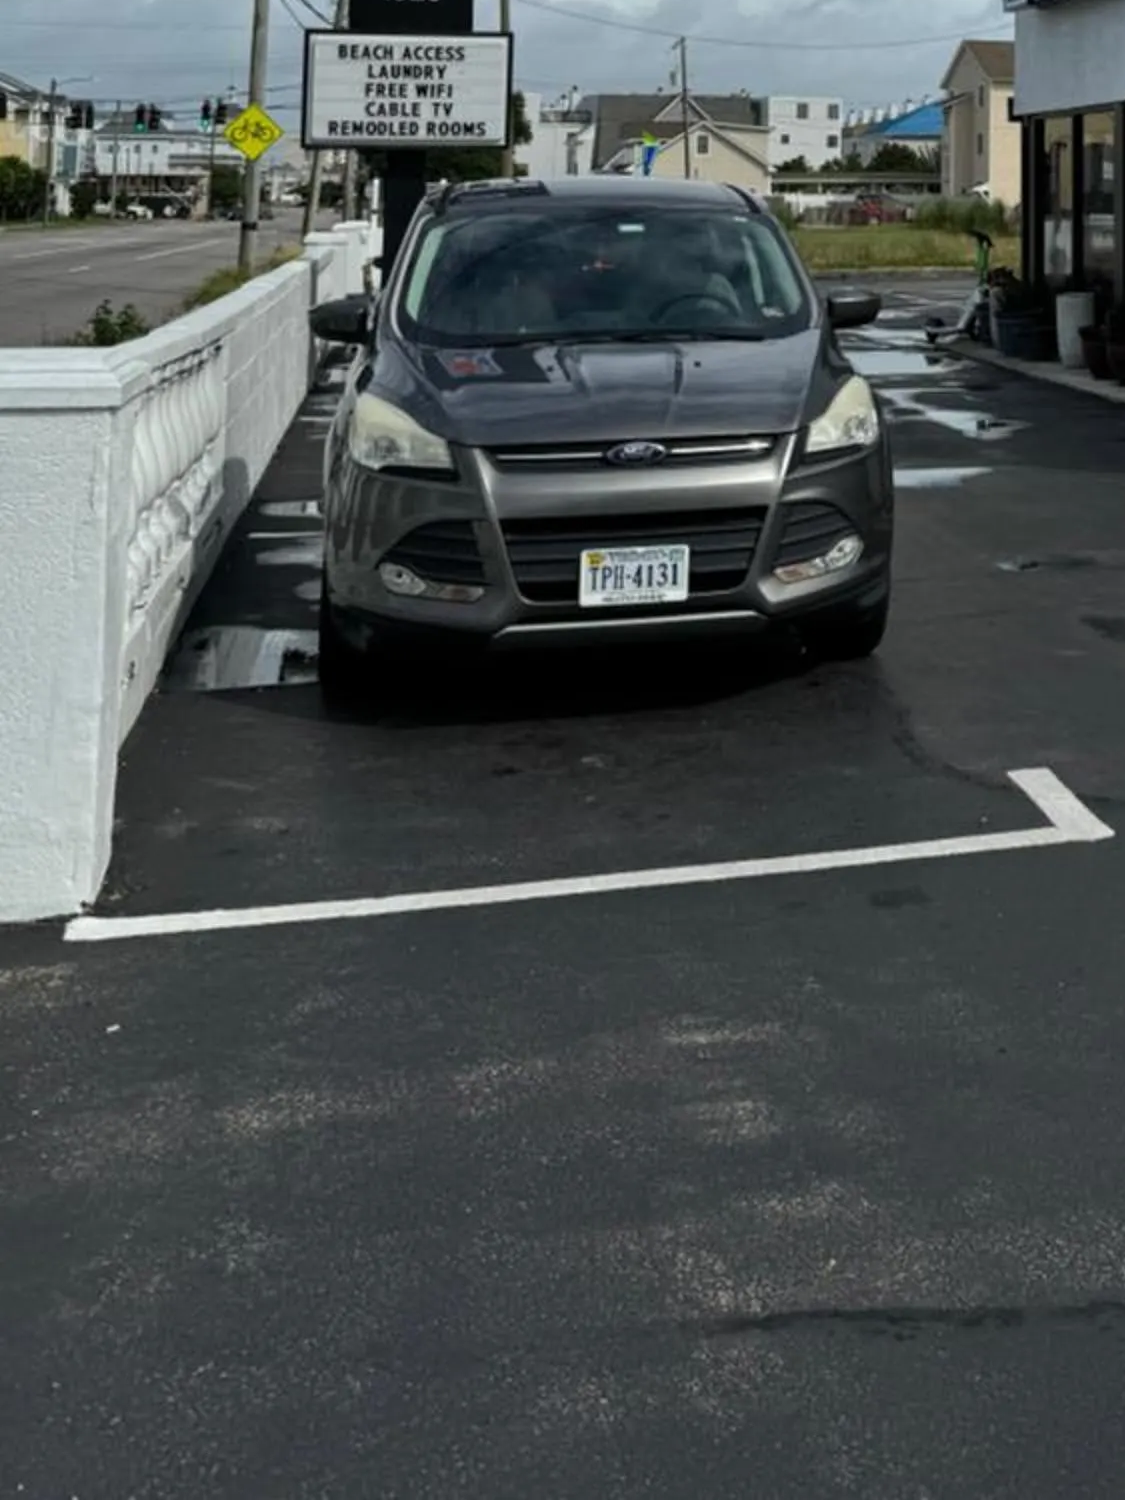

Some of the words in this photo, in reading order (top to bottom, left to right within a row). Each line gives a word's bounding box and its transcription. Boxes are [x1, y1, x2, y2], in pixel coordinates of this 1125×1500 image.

[337, 44, 394, 60] BEACH
[402, 46, 465, 62] ACCESS
[367, 64, 447, 80] LAUNDRY
[364, 83, 407, 98] FREE
[415, 84, 454, 98] WIFI
[365, 102, 421, 118] CABLE
[432, 102, 454, 118] TV
[327, 120, 419, 137] REMODLED
[426, 122, 487, 137] ROOMS
[590, 563, 678, 591] TPH-4131
